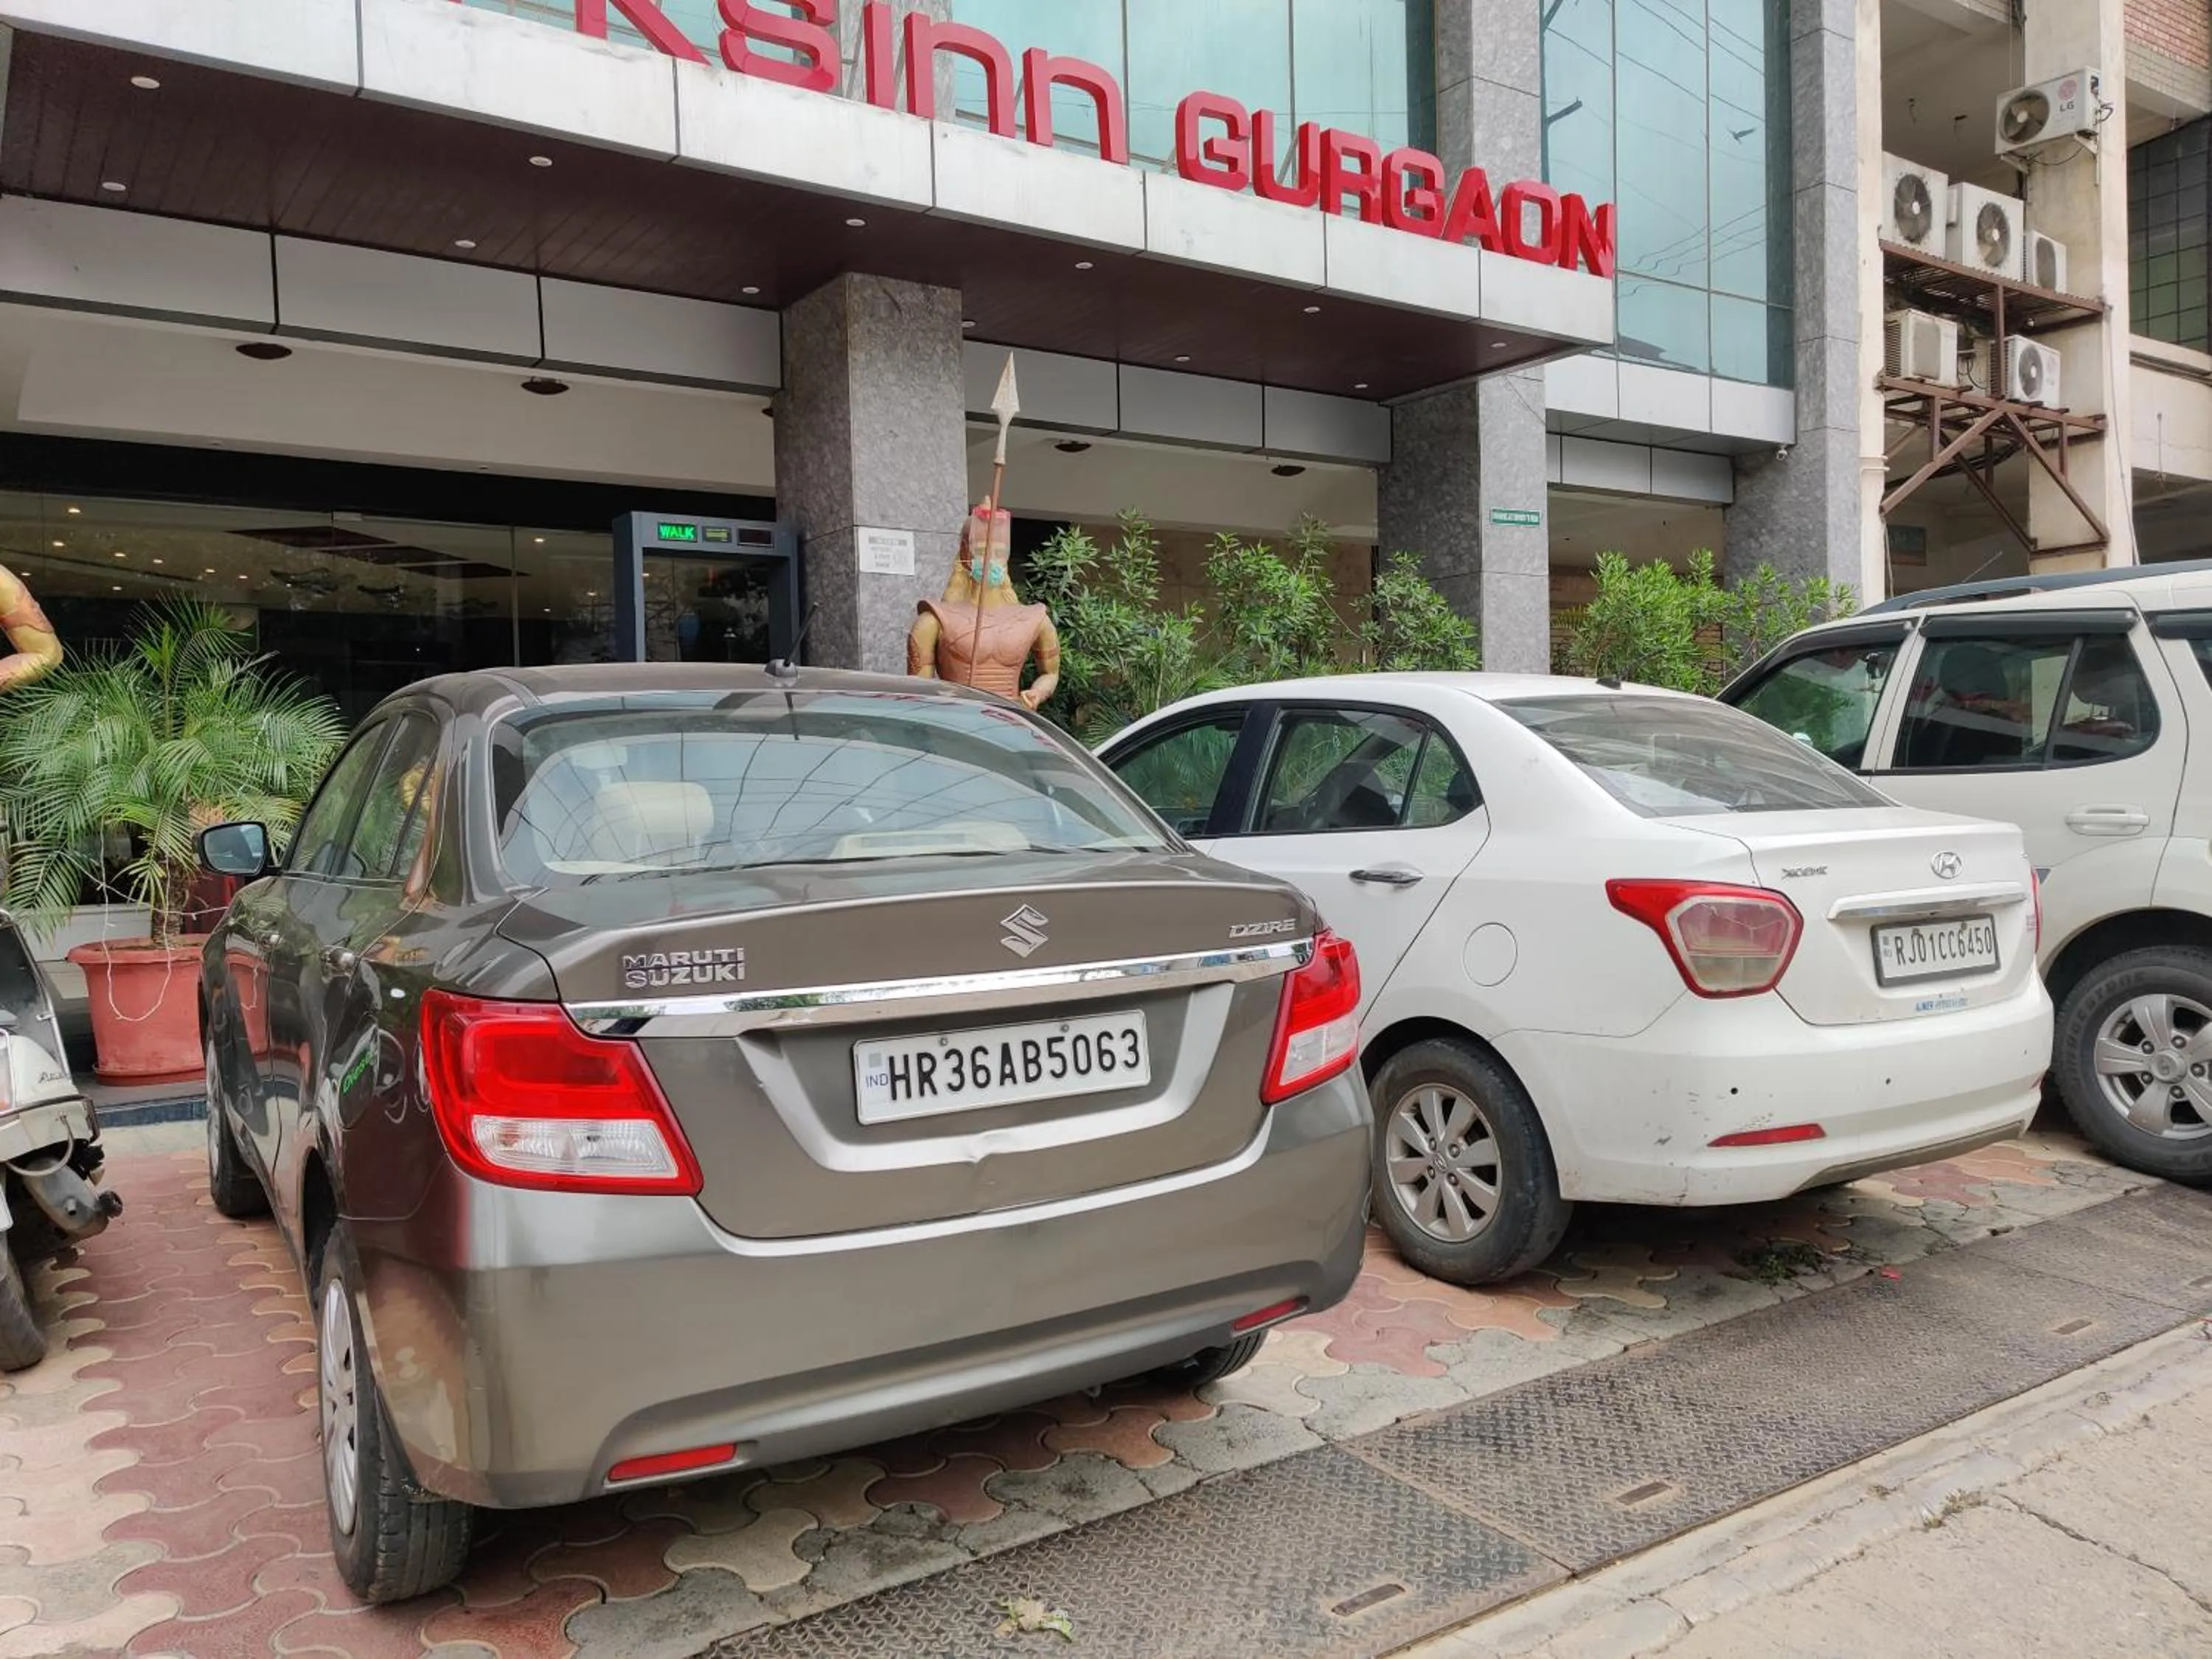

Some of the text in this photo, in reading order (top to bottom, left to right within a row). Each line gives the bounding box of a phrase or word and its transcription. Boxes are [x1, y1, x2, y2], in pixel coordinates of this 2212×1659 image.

[2059, 100, 2075, 112] LG
[1175, 91, 1615, 278] GURGAON
[659, 524, 695, 540] WALK
[1228, 918, 1296, 938] DZIRE
[1894, 925, 1992, 965] RJ01CC6450
[623, 947, 745, 969] MARUTI
[625, 962, 745, 989] SUZUKI
[866, 1028, 1141, 1101] IND HR36AB5063
